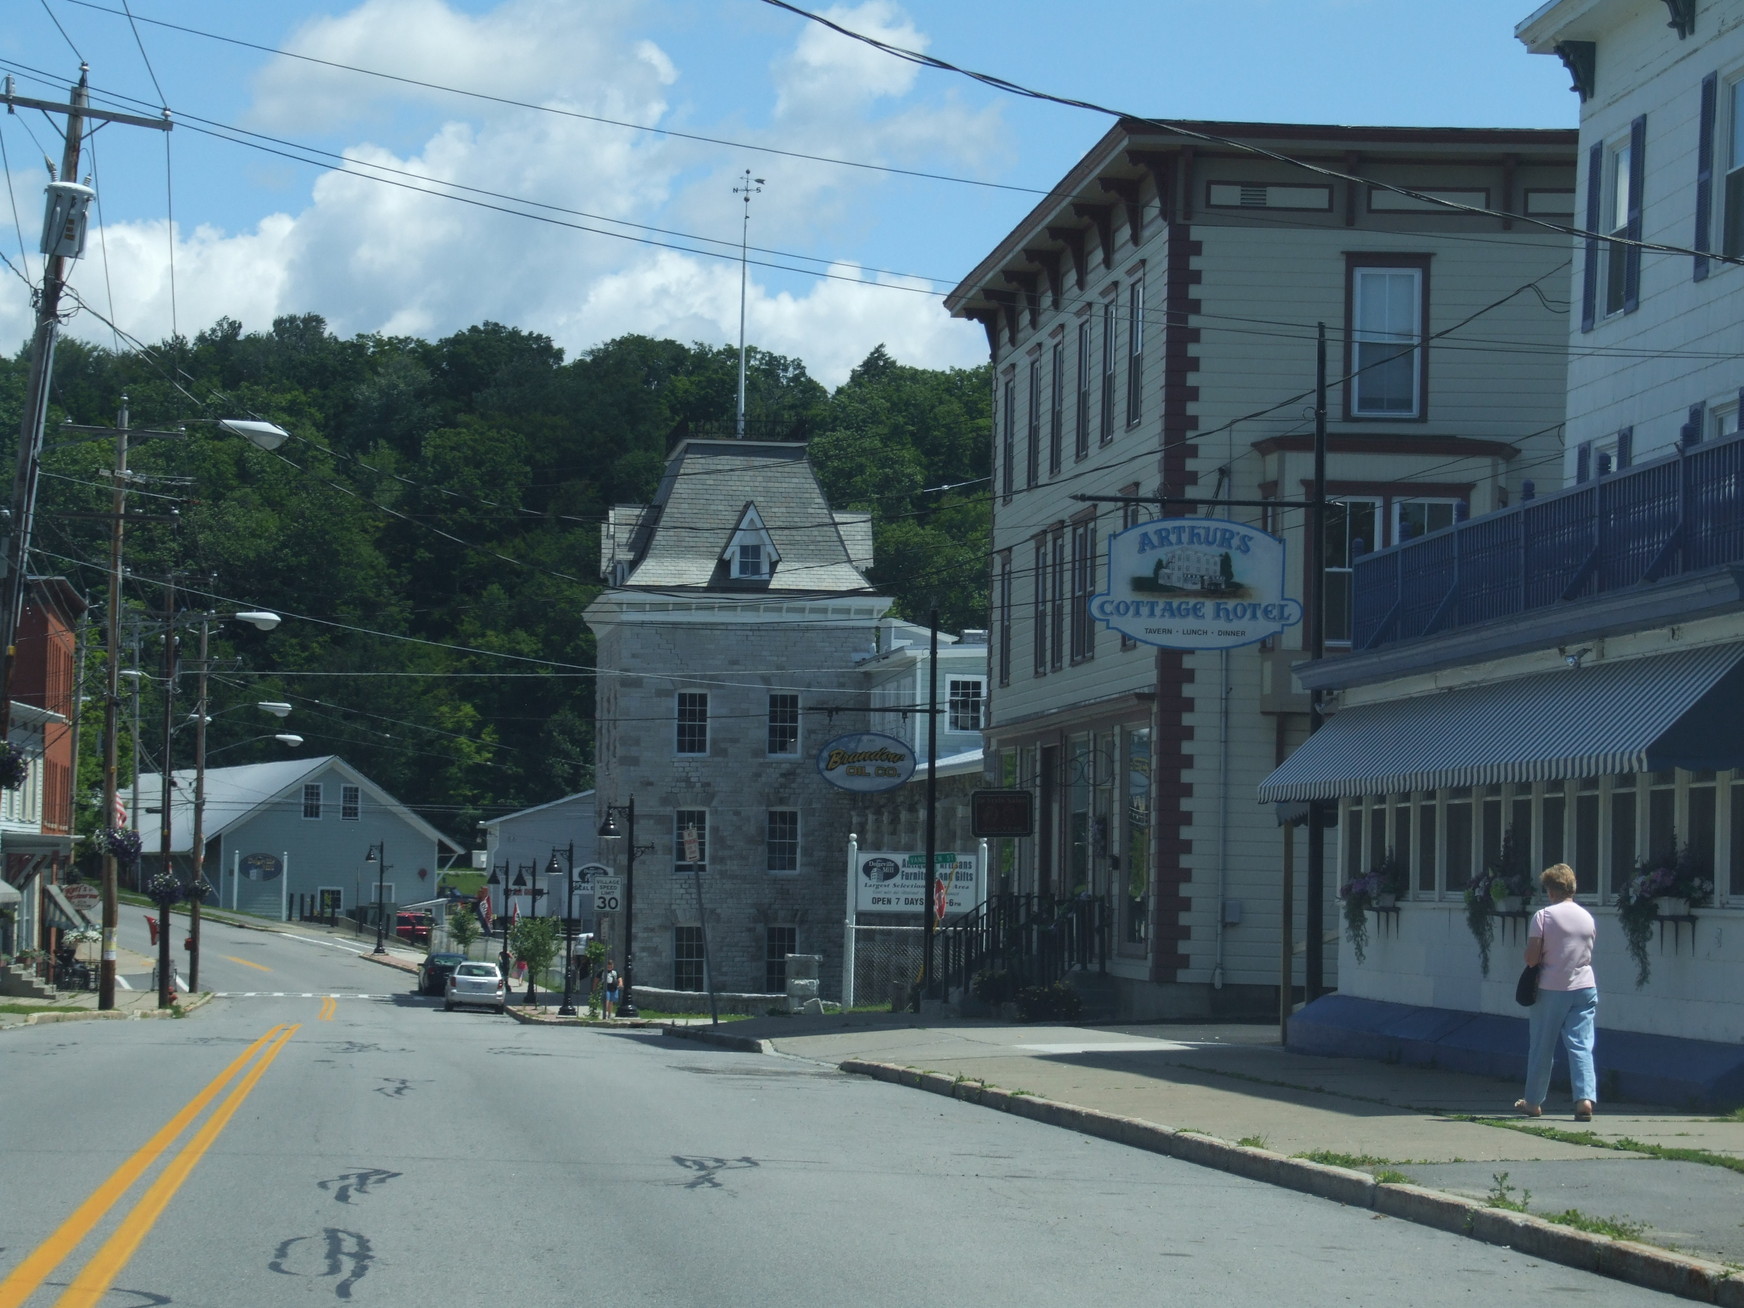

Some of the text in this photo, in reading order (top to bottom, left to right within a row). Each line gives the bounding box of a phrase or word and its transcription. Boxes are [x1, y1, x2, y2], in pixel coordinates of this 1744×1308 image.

[1137, 525, 1254, 554] ARTHUR'S
[1098, 600, 1293, 623] COTTAGE HOTEL
[1144, 627, 1173, 635] TAVERN
[1182, 629, 1208, 637] LUNCH
[846, 766, 902, 778] OIL CO.
[955, 871, 974, 882] Gifts
[596, 896, 619, 910] 30
[871, 897, 892, 905] OPEN
[904, 898, 925, 906] DAYS
